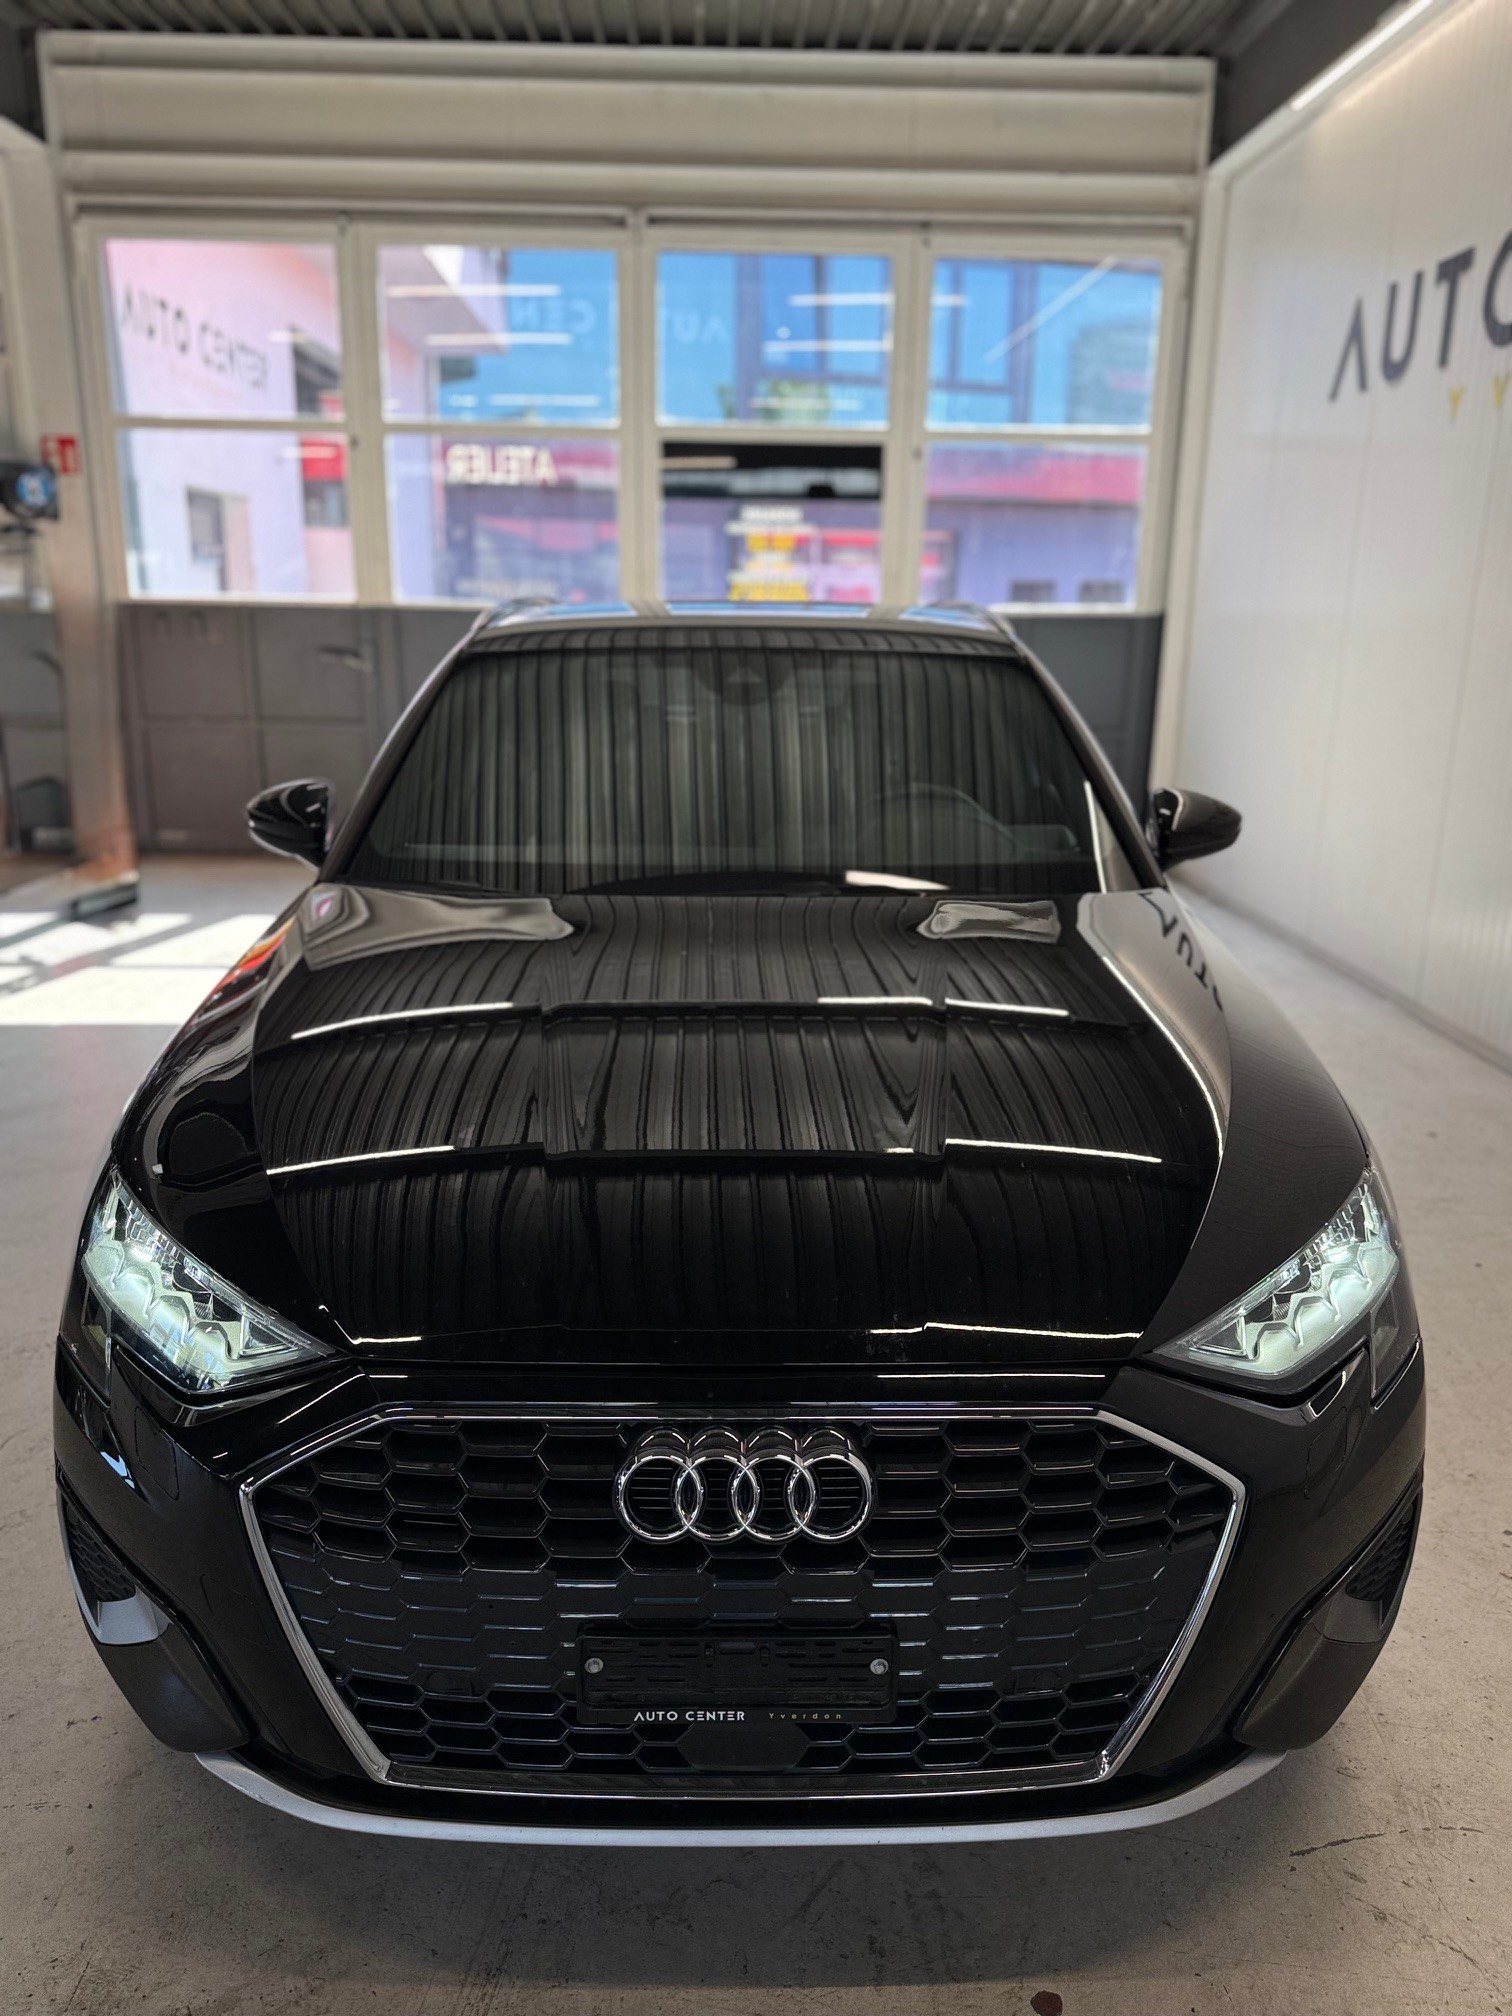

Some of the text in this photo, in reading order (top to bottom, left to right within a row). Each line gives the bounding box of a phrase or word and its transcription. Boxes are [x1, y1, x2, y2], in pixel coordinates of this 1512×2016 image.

[633, 1710, 842, 1722] AUTO CENTER Yverdon
